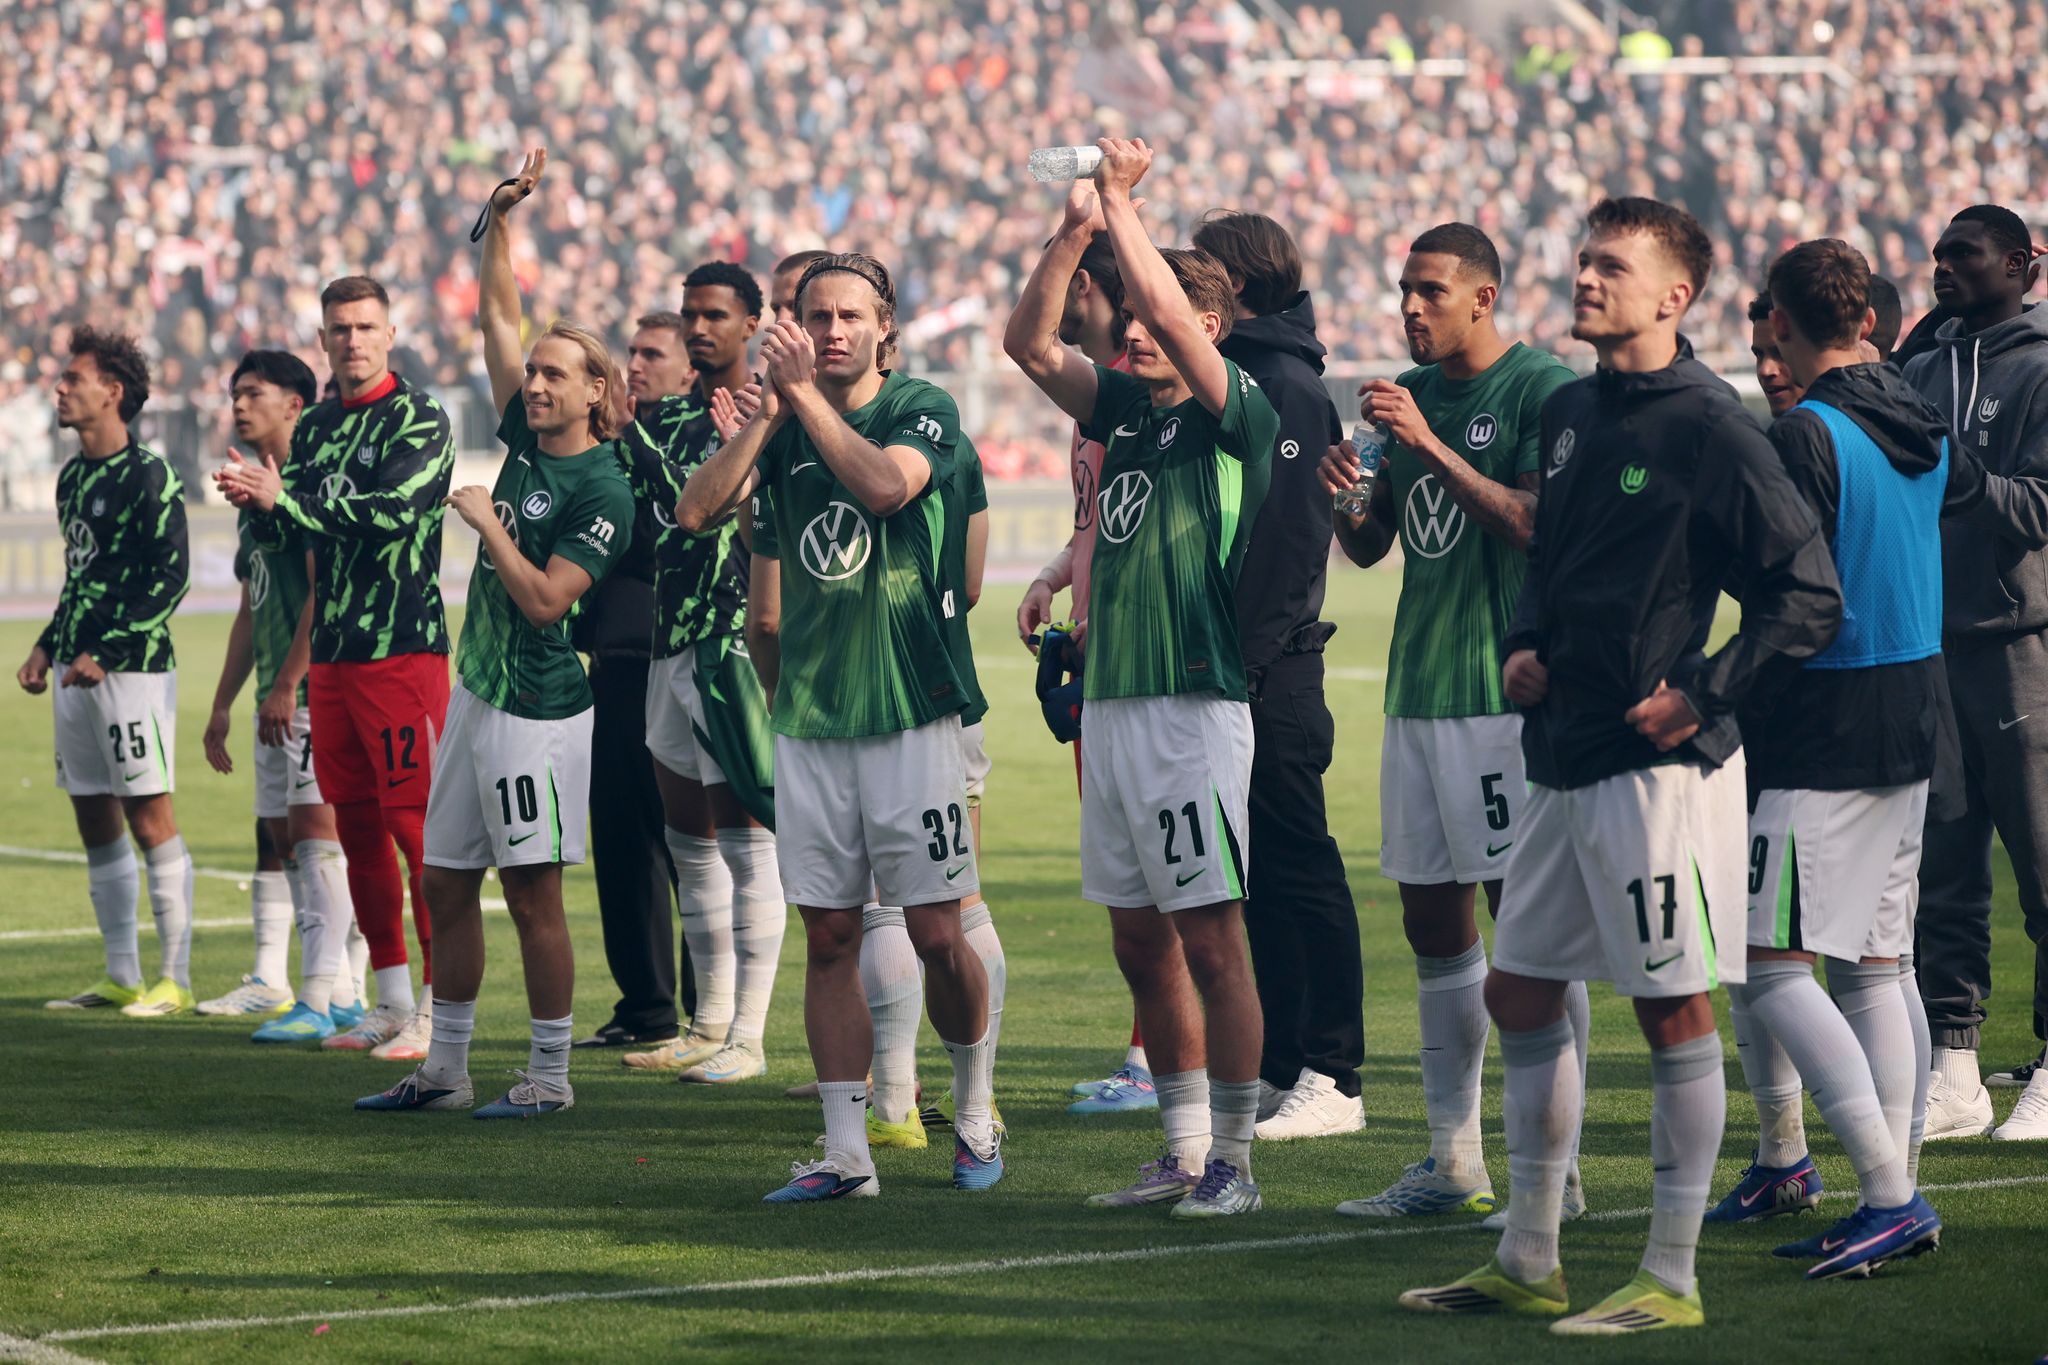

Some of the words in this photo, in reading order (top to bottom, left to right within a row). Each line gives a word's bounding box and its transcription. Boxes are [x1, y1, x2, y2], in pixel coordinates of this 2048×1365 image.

[1979, 430, 1989, 447] 18
[109, 720, 147, 763] 25
[380, 726, 418, 771] 12
[495, 774, 538, 826] 10
[1480, 772, 1510, 831] 5
[921, 802, 969, 862] 32
[1158, 801, 1206, 865] 21
[1748, 834, 1769, 895] 9
[1626, 873, 1678, 943] 17
